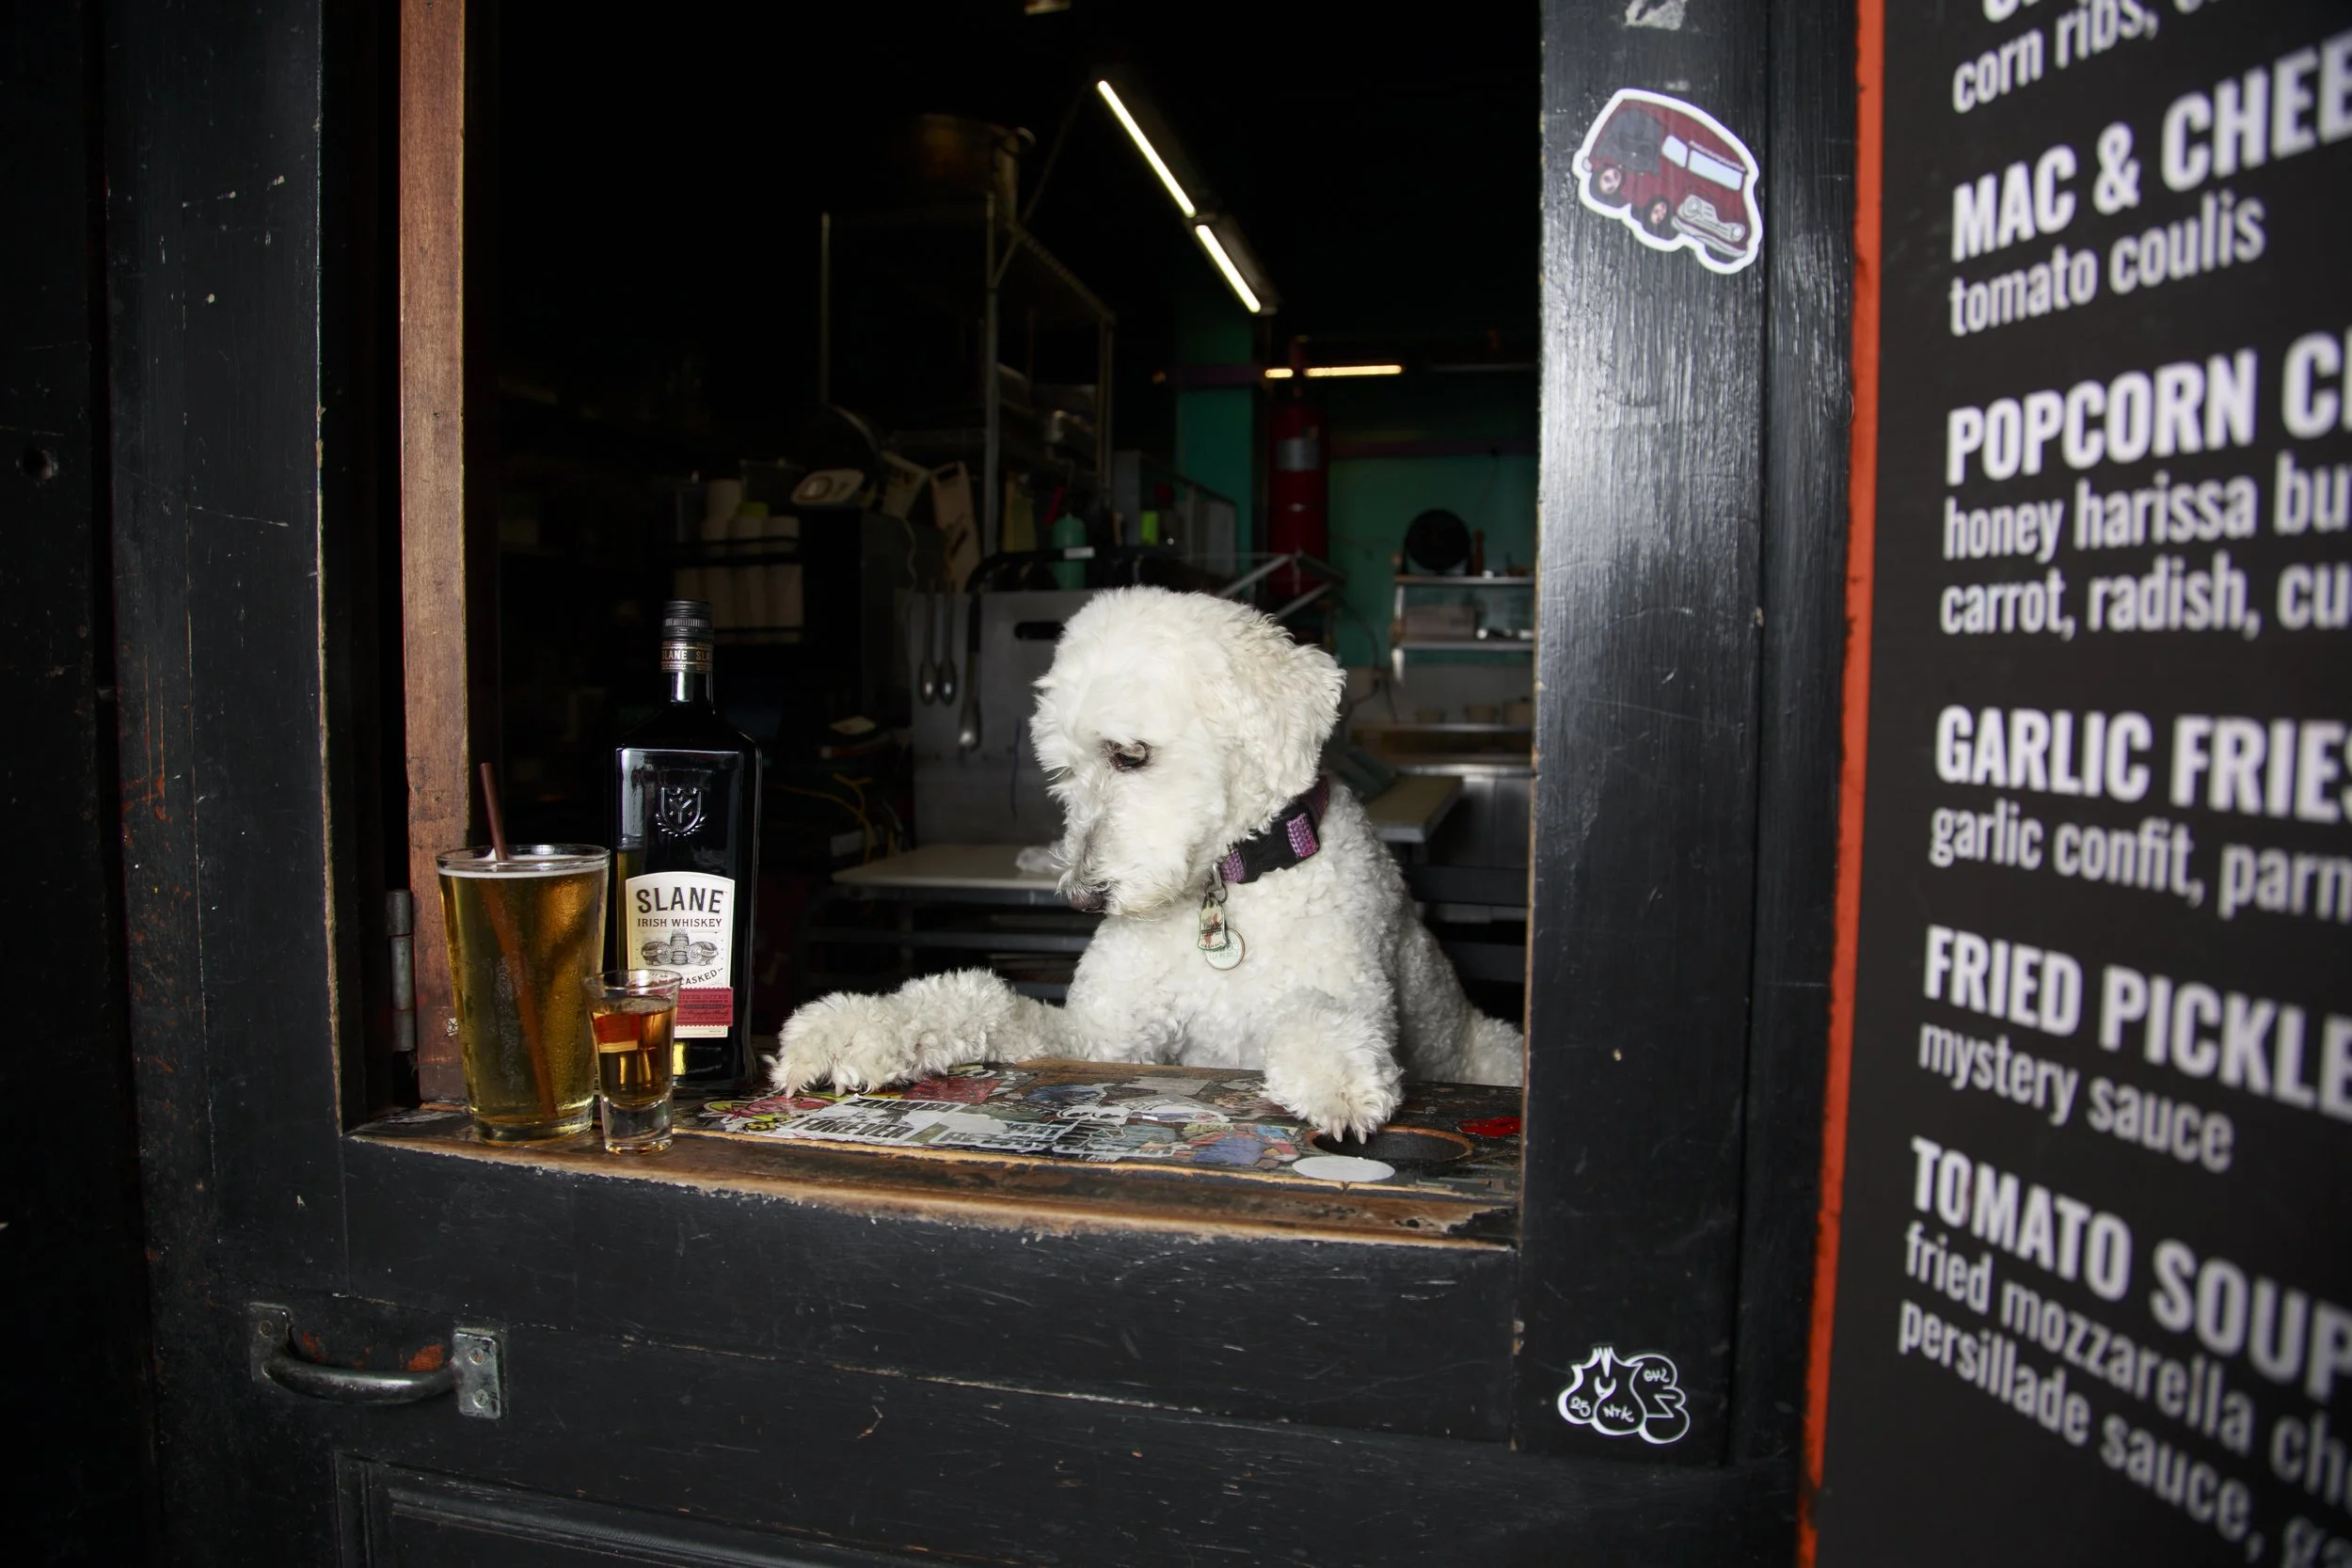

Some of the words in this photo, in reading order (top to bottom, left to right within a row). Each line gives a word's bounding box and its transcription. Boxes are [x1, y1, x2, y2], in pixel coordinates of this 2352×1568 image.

[1952, 29, 2043, 113] corn
[2056, 0, 2159, 69] ribs,
[1951, 146, 2076, 261] MAC
[2094, 123, 2140, 214] &
[1950, 244, 2098, 336] tomato
[2109, 190, 2265, 294] coulis
[1947, 347, 2257, 485] POPCORN
[2282, 325, 2352, 438] C
[1943, 497, 2064, 563] honey
[2074, 470, 2257, 550] harissa
[2274, 450, 2352, 534] bu
[1941, 567, 2075, 641] carrot,
[2087, 545, 2260, 641] radish,
[2277, 563, 2352, 629] cu
[1935, 705, 2153, 801] GARLIC
[2169, 714, 2352, 823] FRIE
[636, 886, 724, 914] SLANE
[1930, 798, 2043, 869] garlic
[2054, 816, 2205, 908] confit,
[637, 918, 667, 927] IRISH
[671, 917, 723, 927] WHISKEY
[1924, 924, 2083, 1035] FRIED
[789, 1117, 916, 1140] FOREVER
[844, 1097, 961, 1114] ZUMBI
[1918, 1022, 2078, 1127] mystery
[2088, 1077, 2234, 1174] sauce
[1912, 1135, 2133, 1301] TOMATO
[2150, 1239, 2352, 1402] SOUP
[1905, 1221, 1993, 1314] fried
[2001, 1280, 2255, 1457] mozzarella
[2268, 1412, 2352, 1516] ch
[1899, 1300, 2090, 1445] persillade
[2101, 1415, 2265, 1562] sauce,
